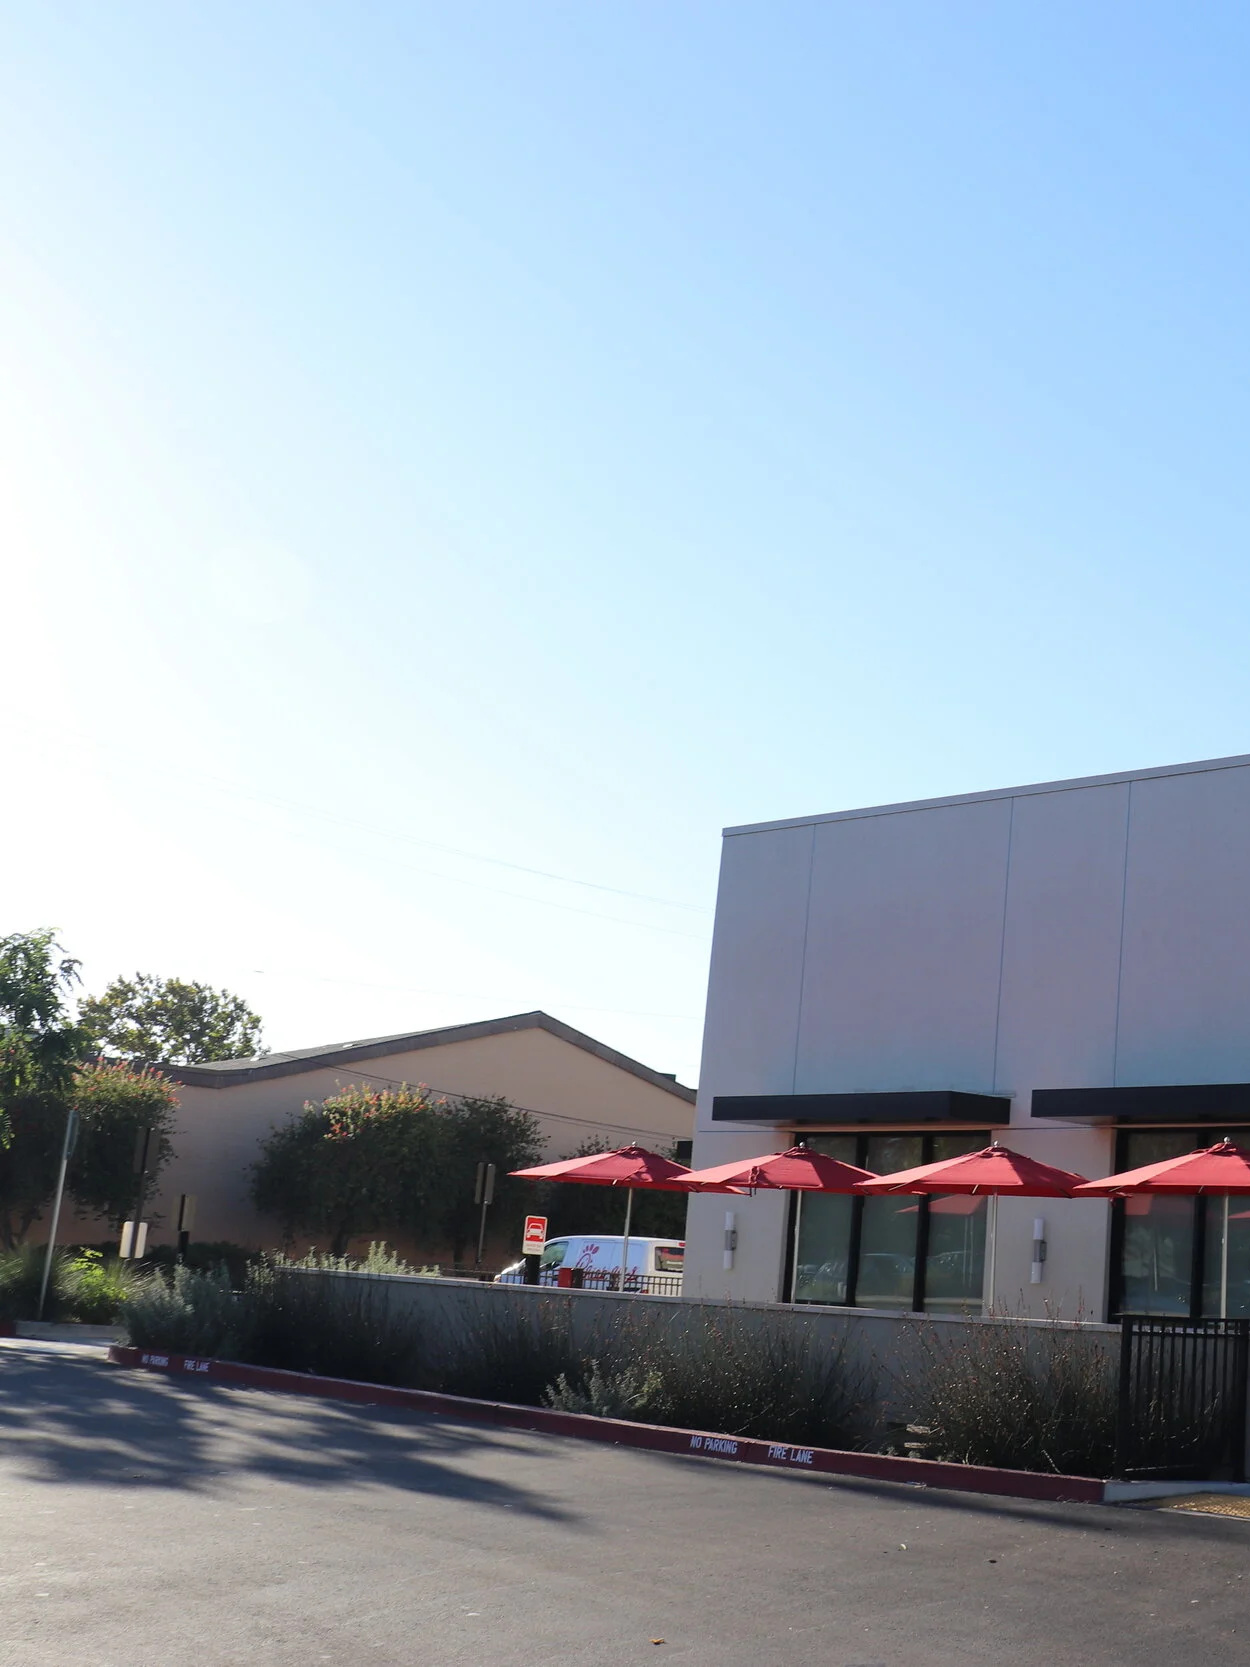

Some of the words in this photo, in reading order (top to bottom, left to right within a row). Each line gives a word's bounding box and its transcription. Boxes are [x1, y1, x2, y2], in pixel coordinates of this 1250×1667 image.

[689, 1435, 703, 1449] NO
[704, 1437, 739, 1455] PARKING
[768, 1445, 788, 1460] FIRE
[790, 1448, 815, 1464] LANE
